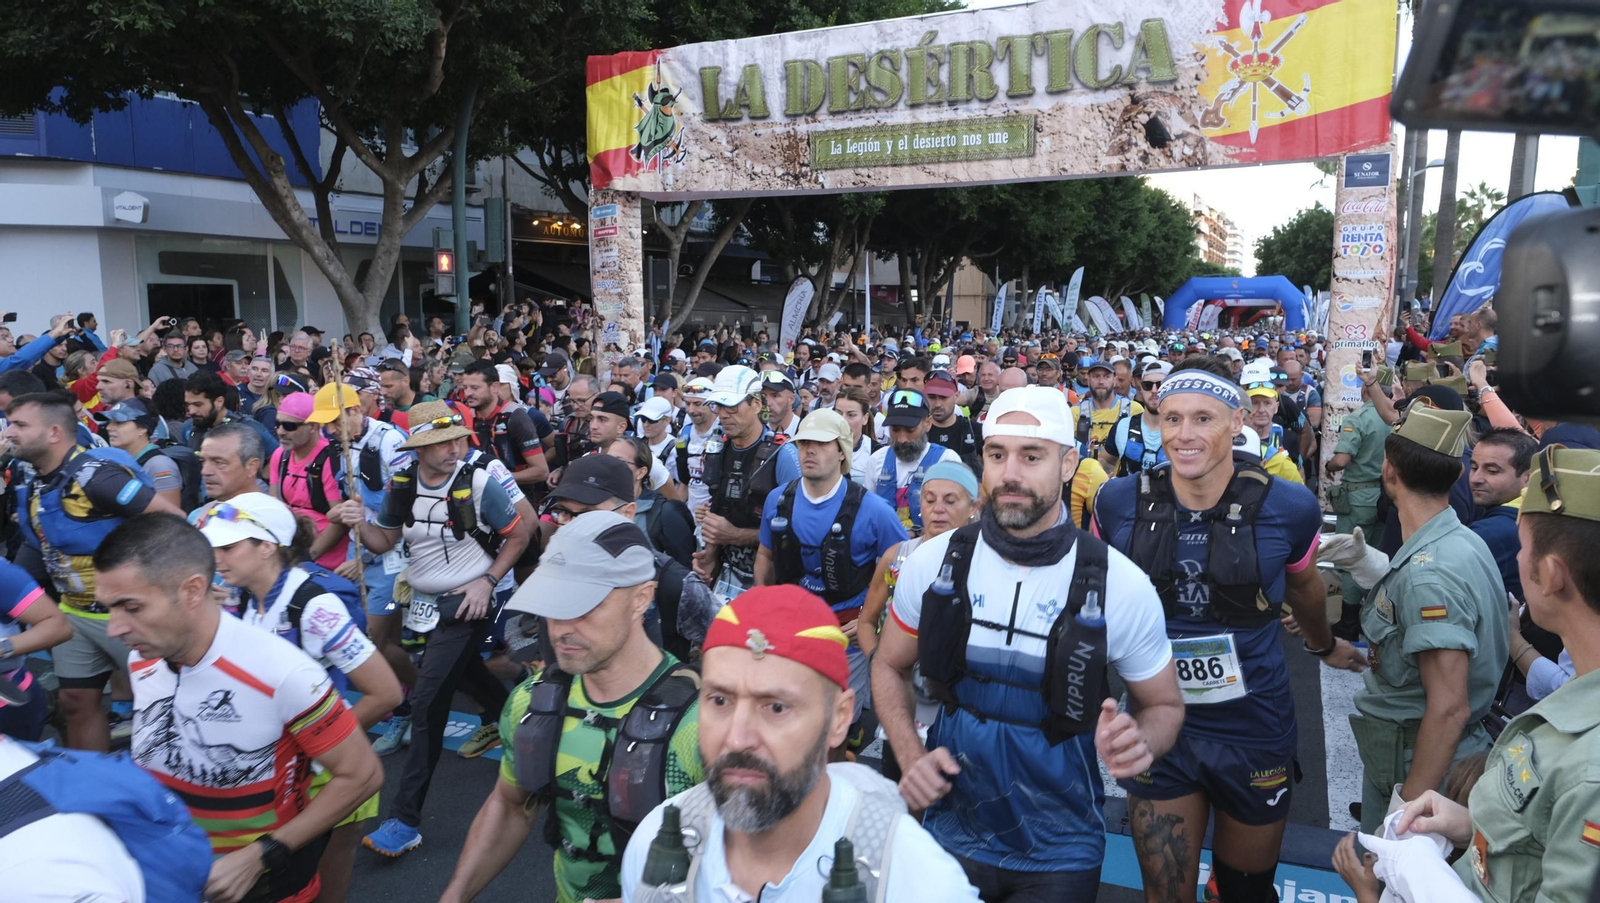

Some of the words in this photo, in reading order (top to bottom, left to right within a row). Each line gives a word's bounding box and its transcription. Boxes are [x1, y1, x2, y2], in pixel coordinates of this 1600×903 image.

[700, 64, 770, 121] LA
[783, 17, 1179, 116] DESÉRTICA
[831, 140, 842, 155] La
[846, 137, 881, 157] Legión
[886, 139, 893, 154] y
[898, 135, 909, 150] el
[913, 131, 957, 149] desierto
[962, 134, 982, 146] nos
[988, 131, 1009, 144] une
[543, 225, 587, 238] AUTOMO
[1342, 233, 1384, 243] RENTA
[1341, 244, 1384, 257] TODO
[597, 280, 617, 289] BBVA
[1334, 340, 1379, 349] primaflor
[825, 548, 838, 591] KIPRUN
[1176, 656, 1224, 681] 886
[1065, 641, 1095, 722] KIPRUN
[1250, 769, 1260, 778] LA
[1260, 766, 1287, 778] LEGIÓN
